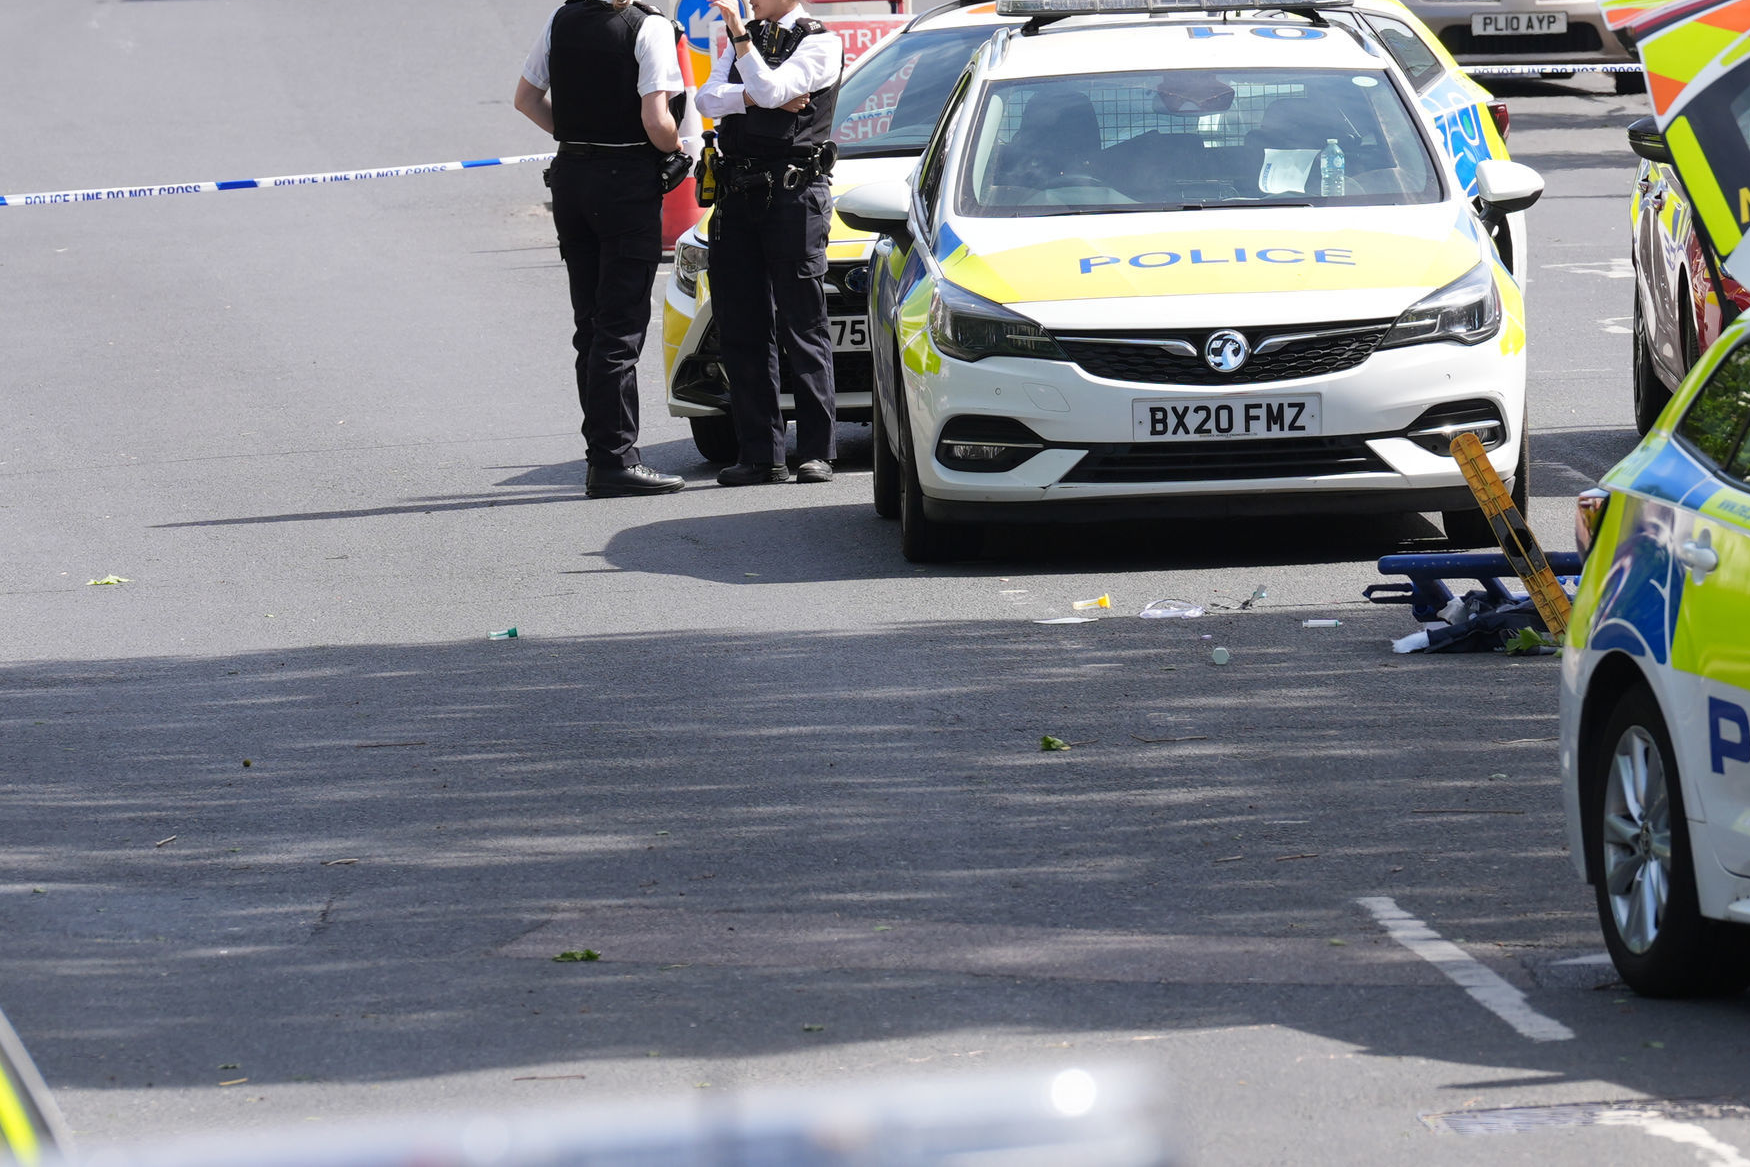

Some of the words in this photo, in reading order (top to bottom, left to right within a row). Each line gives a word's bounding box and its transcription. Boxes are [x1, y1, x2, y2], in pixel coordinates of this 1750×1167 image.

[1482, 17, 1520, 32] PL10
[1525, 15, 1557, 31] AYP
[376, 169, 402, 180] NOT
[24, 194, 71, 205] POLICE
[74, 192, 103, 203] LINE
[106, 189, 126, 200] DO
[129, 187, 155, 198] NOT
[158, 184, 202, 196] CROSS
[1079, 247, 1356, 275] POLICE
[830, 319, 866, 347] 75
[1149, 404, 1234, 436] BX20
[1243, 402, 1307, 433] FMZ
